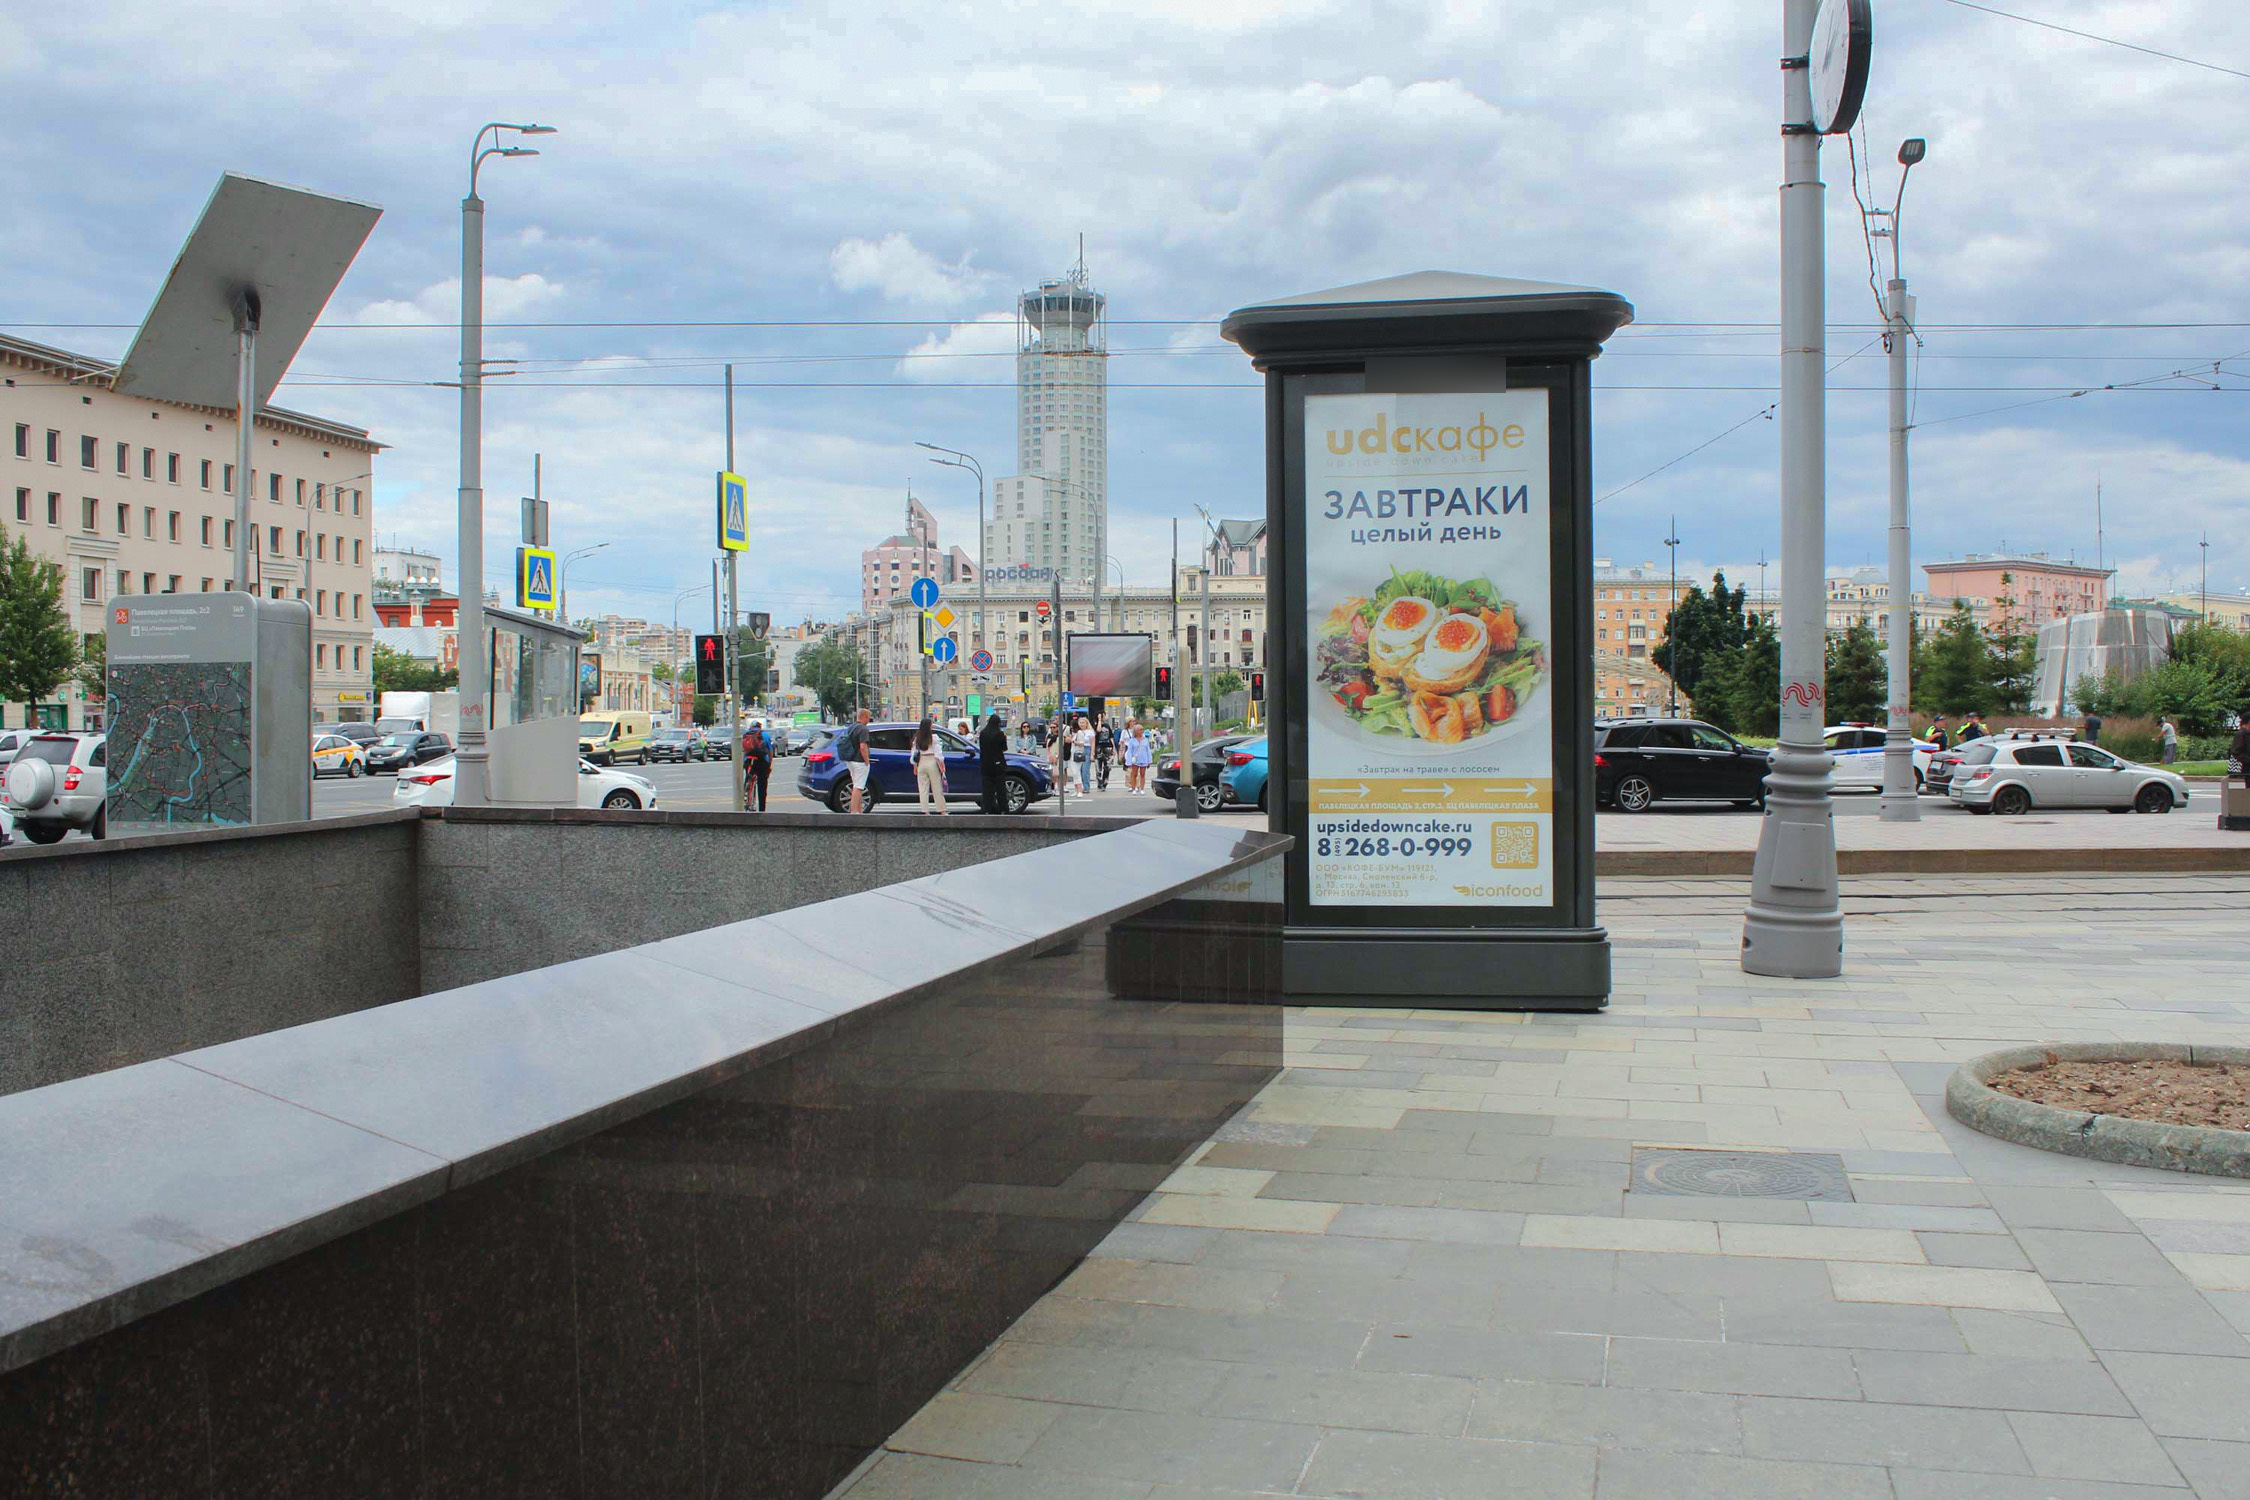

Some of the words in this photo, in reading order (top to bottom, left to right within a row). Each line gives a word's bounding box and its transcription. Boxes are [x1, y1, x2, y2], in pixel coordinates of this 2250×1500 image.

[1323, 484, 1528, 520] ЗАВТРАКИ
[1351, 522, 1432, 545] целый
[1440, 524, 1502, 544] день
[1357, 764, 1400, 775] «Завтрак
[1417, 766, 1449, 775] траве»
[1459, 765, 1500, 773] лососем
[1371, 802, 1413, 810] ПЛОЩАДЬ
[1317, 819, 1472, 836] upsidedowncake.ru
[1317, 837, 1331, 857] 8
[1334, 837, 1342, 857] (495)
[1345, 837, 1472, 857] 268-0-999
[1315, 889, 1339, 897] ОГРН
[1470, 884, 1543, 897] iconfood
